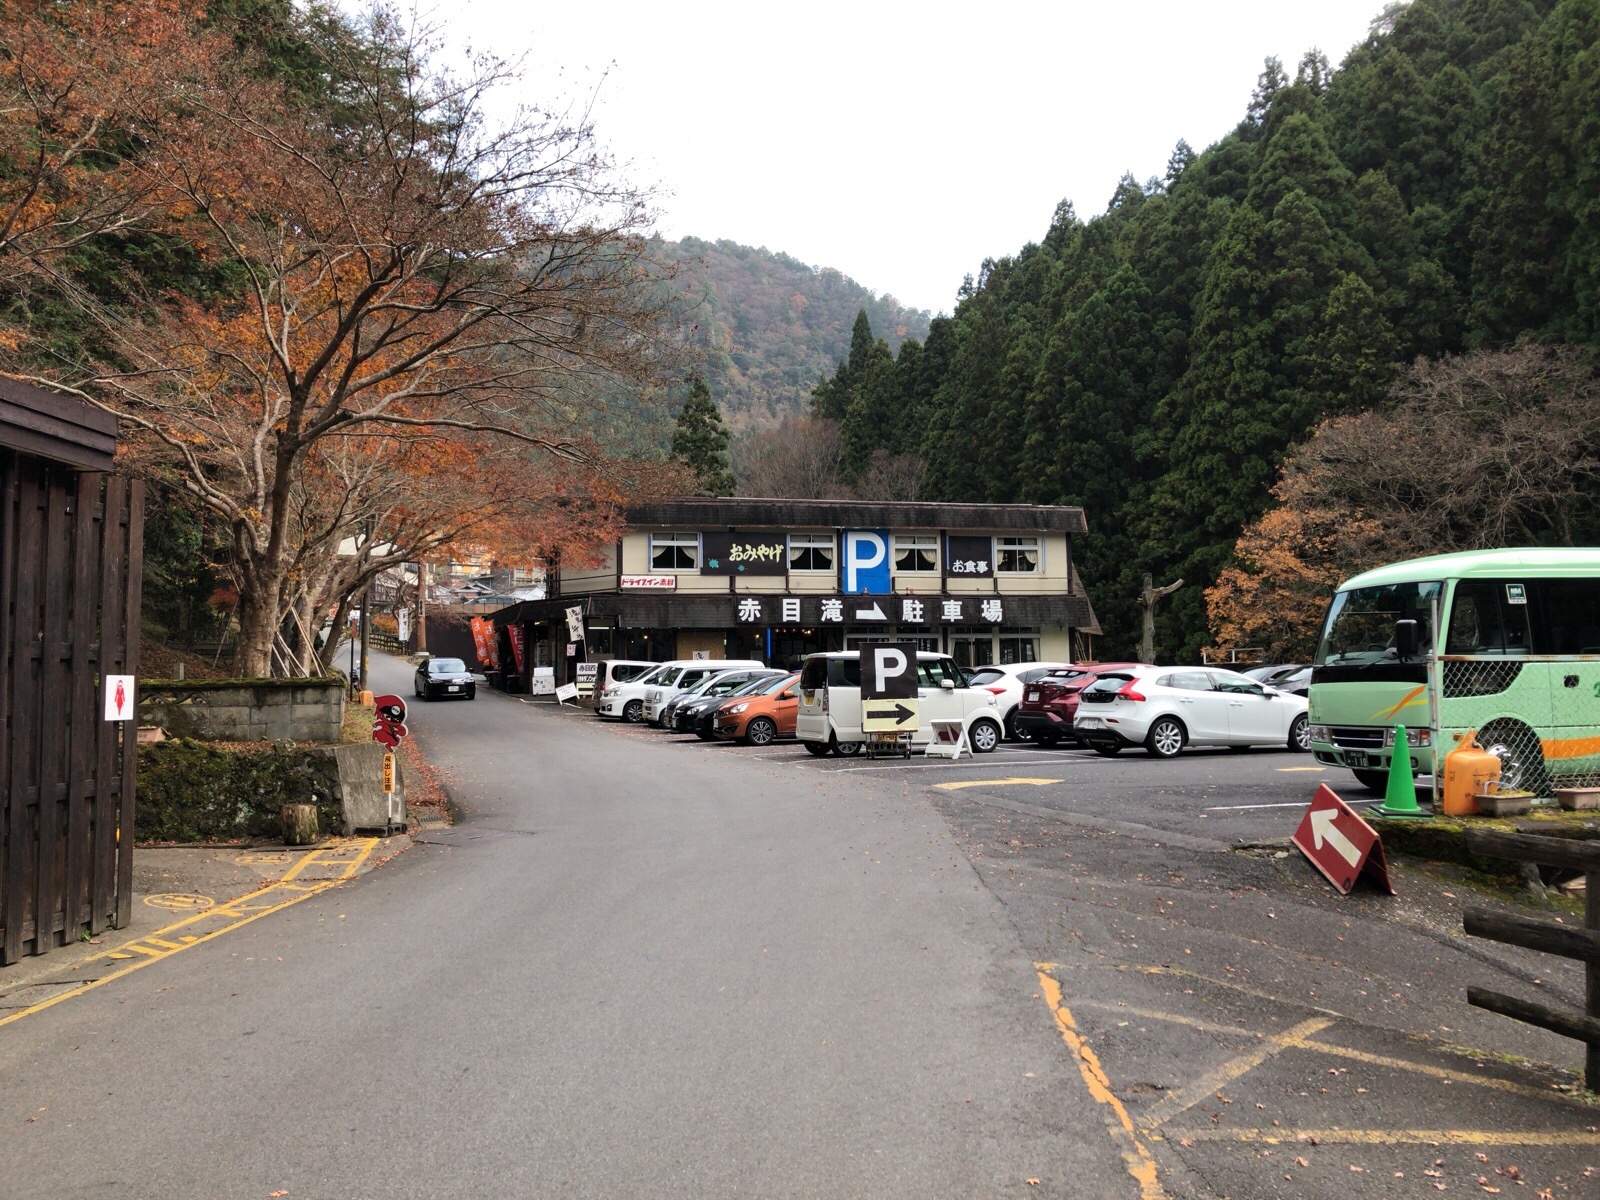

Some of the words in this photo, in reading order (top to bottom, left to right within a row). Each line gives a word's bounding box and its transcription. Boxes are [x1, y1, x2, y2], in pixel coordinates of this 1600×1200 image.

[729, 543, 785, 563] おみやげ
[847, 531, 886, 592] P
[952, 559, 989, 574] お食事
[621, 578, 674, 586] ドライブイン赤目
[738, 598, 844, 622] 赤目滝
[902, 599, 1004, 623] 駐車場
[874, 647, 908, 693] P
